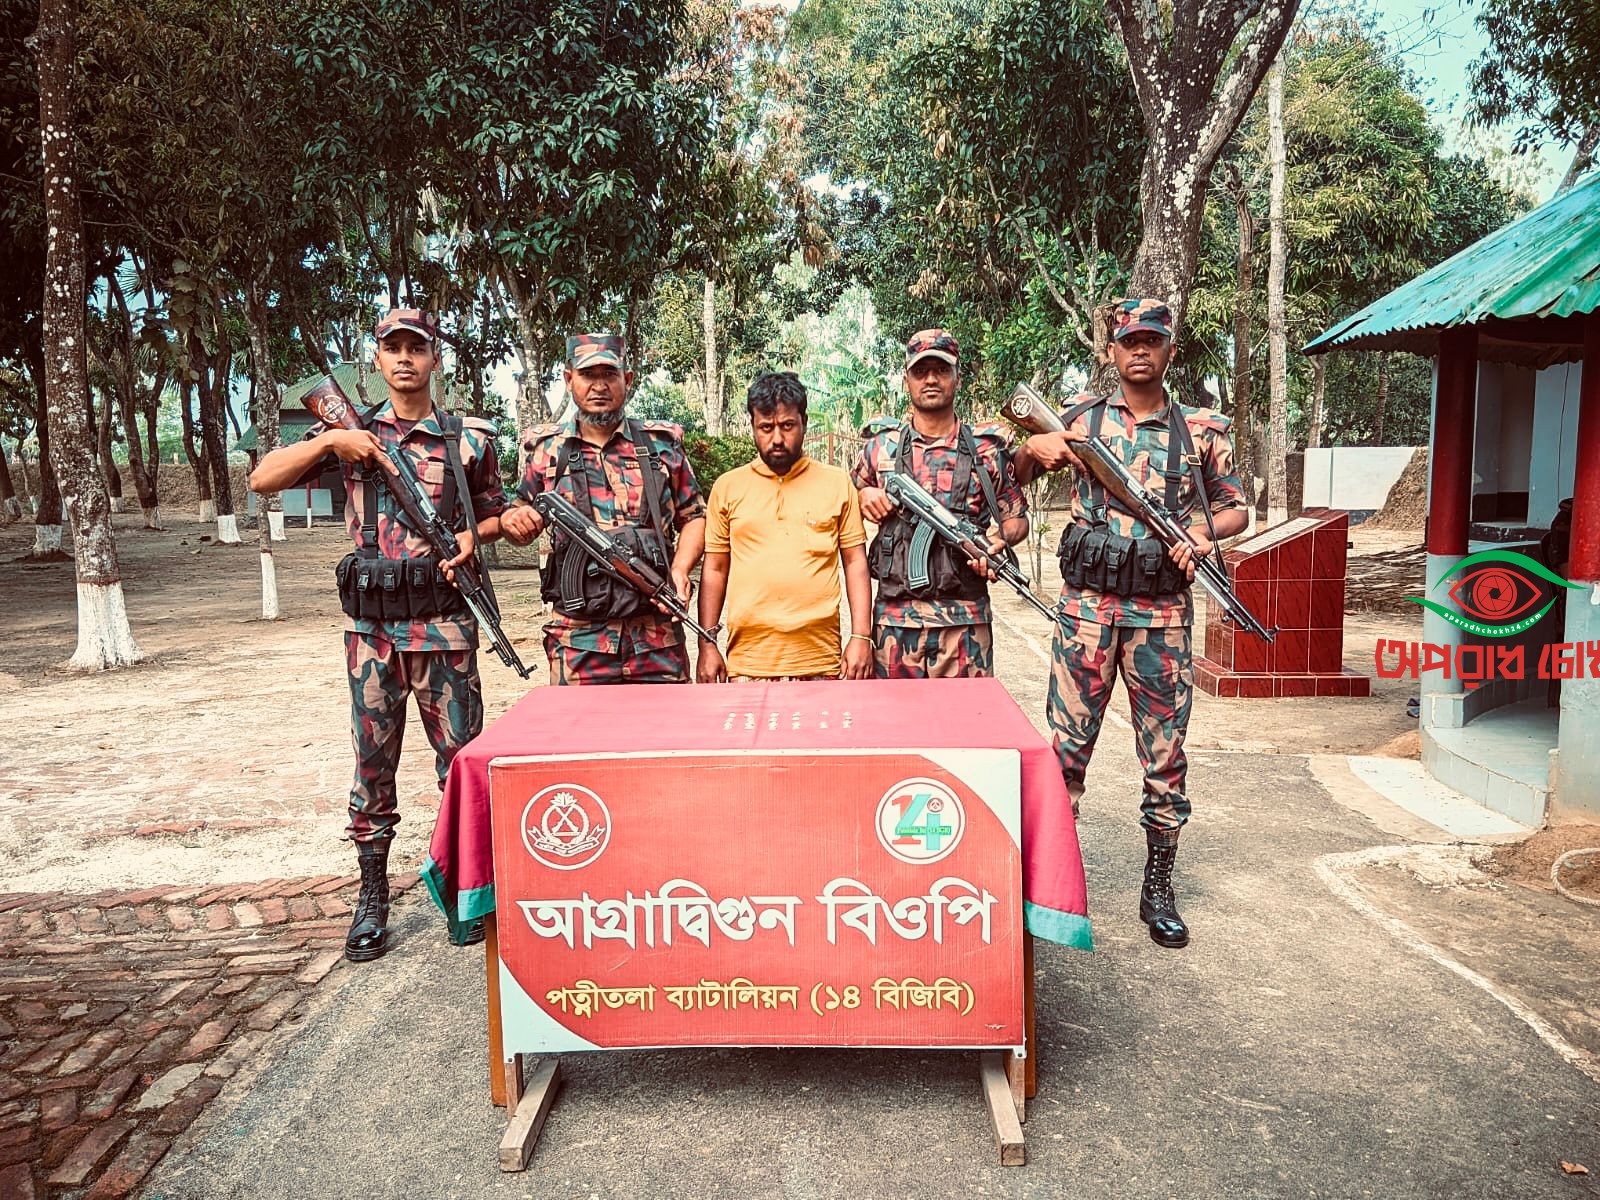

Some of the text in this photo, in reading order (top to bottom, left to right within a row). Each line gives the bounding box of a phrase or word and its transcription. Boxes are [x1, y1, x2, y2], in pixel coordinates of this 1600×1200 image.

[516, 877, 998, 950] আগ্রাদ্বিগুন বিওপি
[545, 976, 976, 1019] পত্নীতলা ব্যাটালিয়ন (১৪ বিজিবি)
